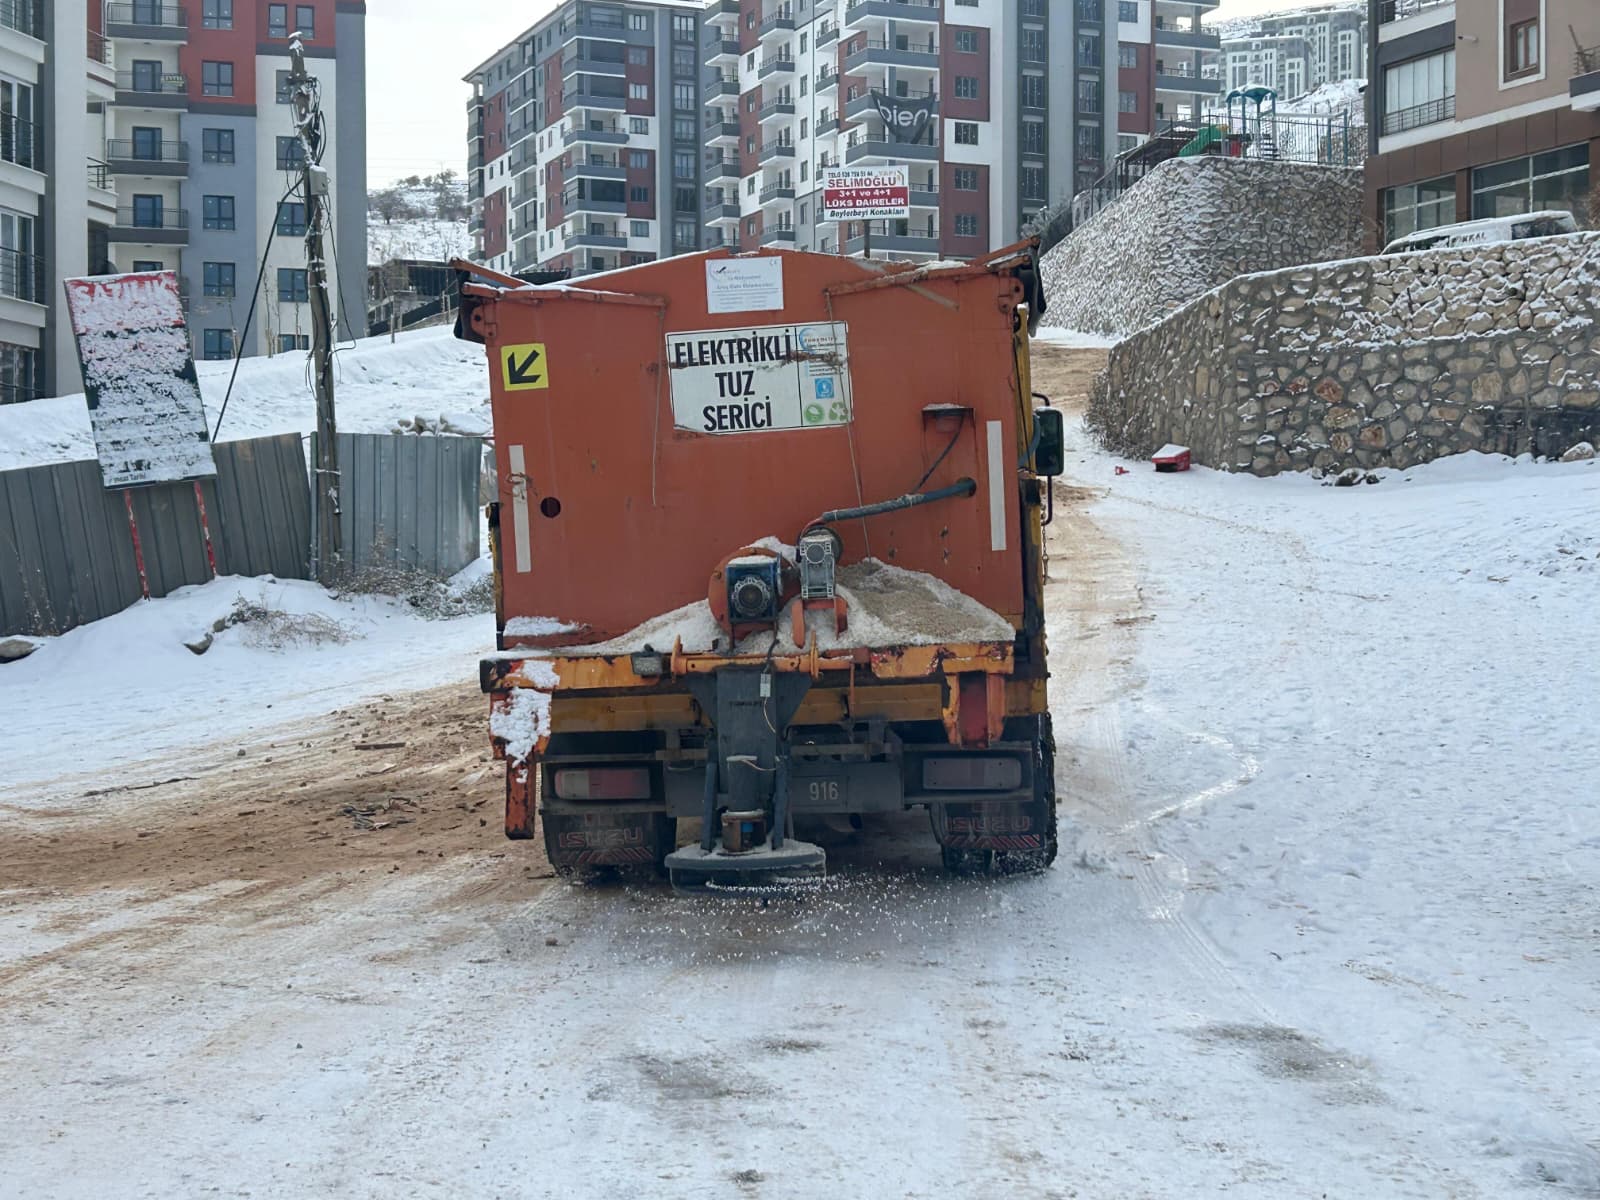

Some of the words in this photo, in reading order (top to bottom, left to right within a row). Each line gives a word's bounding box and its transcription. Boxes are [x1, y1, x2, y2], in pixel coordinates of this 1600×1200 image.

[828, 175, 897, 188] SELİMOĞLU
[839, 189, 856, 197] 3+1
[873, 188, 891, 196] 4+1
[674, 329, 791, 367] ELEKTRİKLİ
[715, 370, 755, 397] TUZ
[702, 395, 773, 431] SERİCİ
[809, 781, 840, 801] 916
[947, 815, 1031, 833] ISUZU
[559, 827, 643, 848] ISUZU
